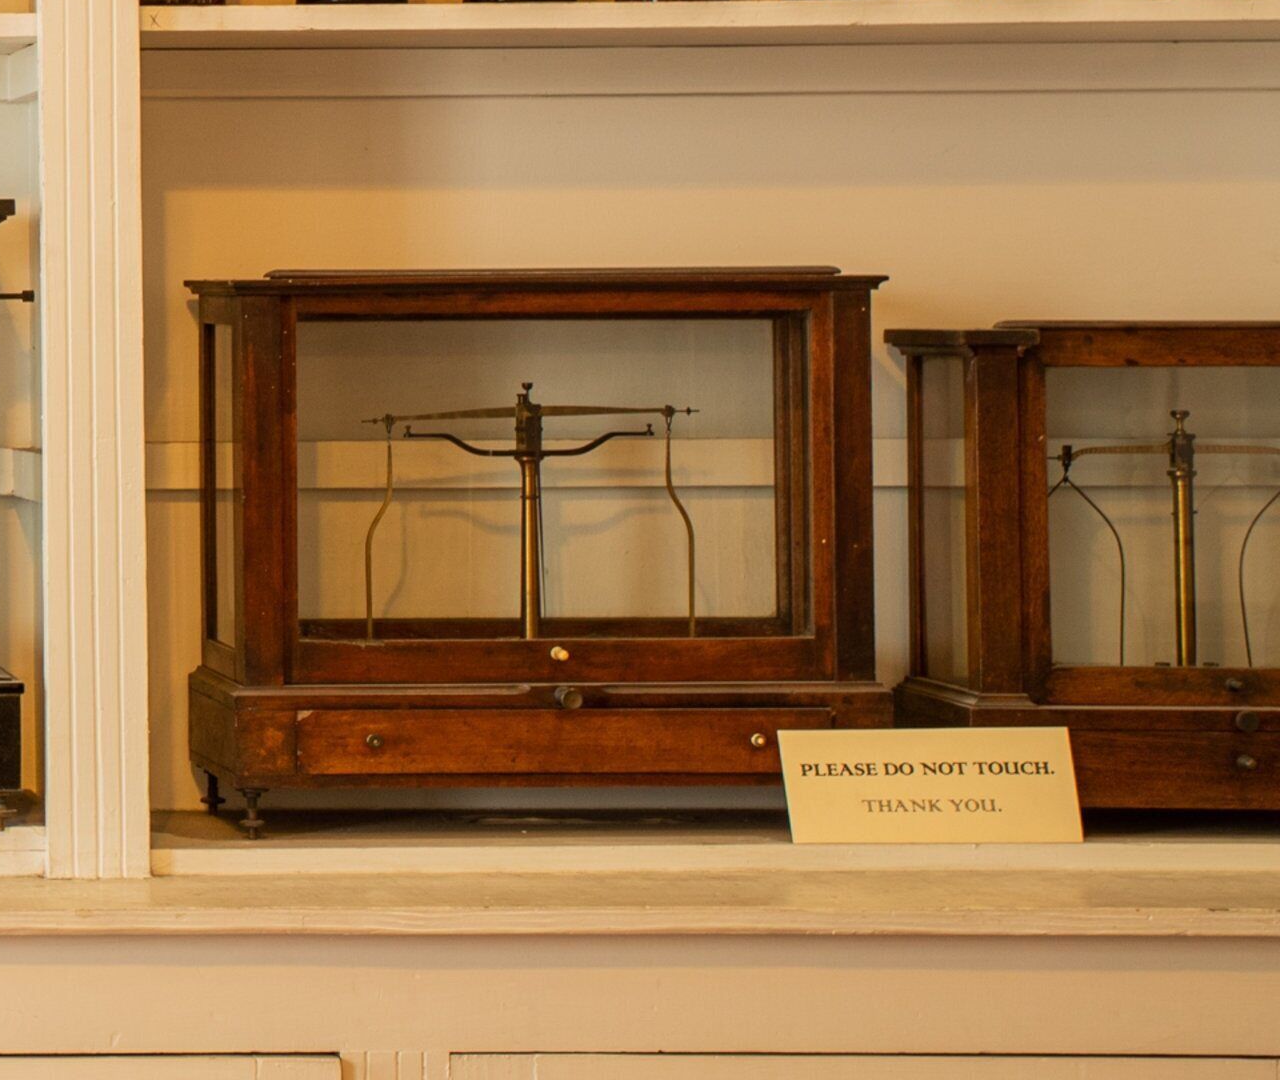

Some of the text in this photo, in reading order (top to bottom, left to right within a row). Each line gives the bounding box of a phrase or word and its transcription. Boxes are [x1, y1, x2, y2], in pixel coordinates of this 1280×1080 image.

[801, 762, 1056, 778] PLEASE DO NOT TOUCH.
[861, 799, 1003, 814] THANK YOU.
